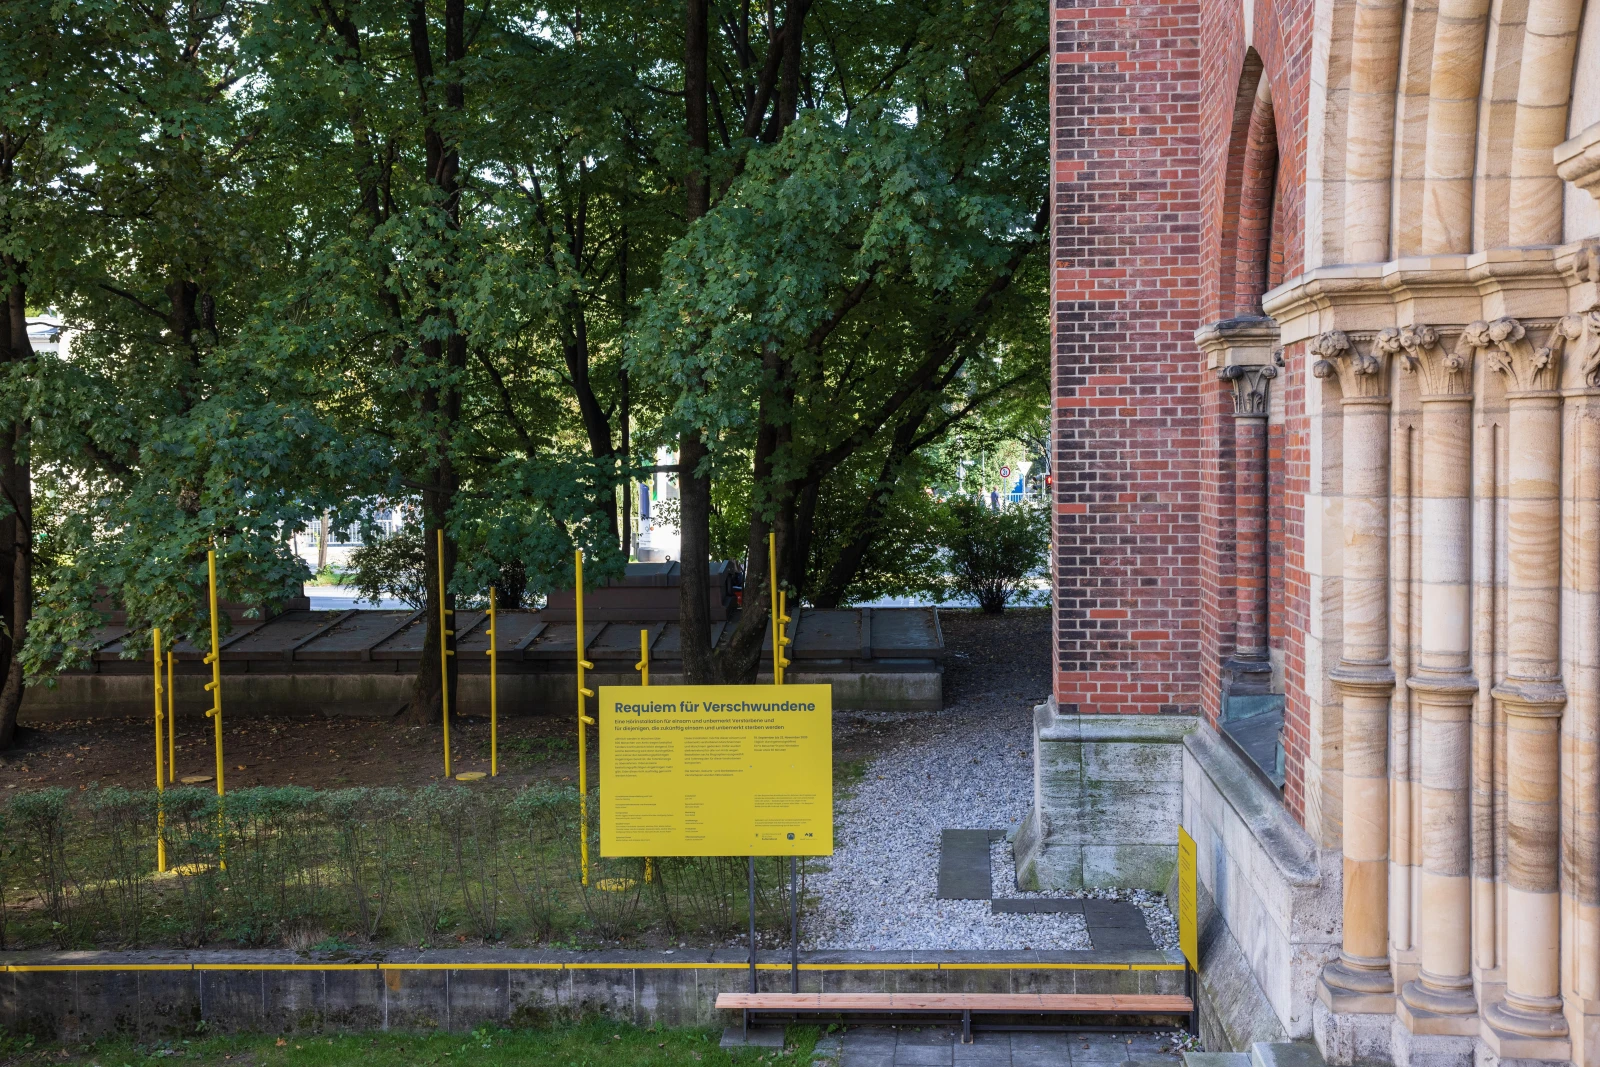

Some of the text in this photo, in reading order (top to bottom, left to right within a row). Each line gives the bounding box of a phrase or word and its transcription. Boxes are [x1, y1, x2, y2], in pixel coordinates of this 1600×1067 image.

[615, 701, 816, 716] Requiem für Verschwundene
